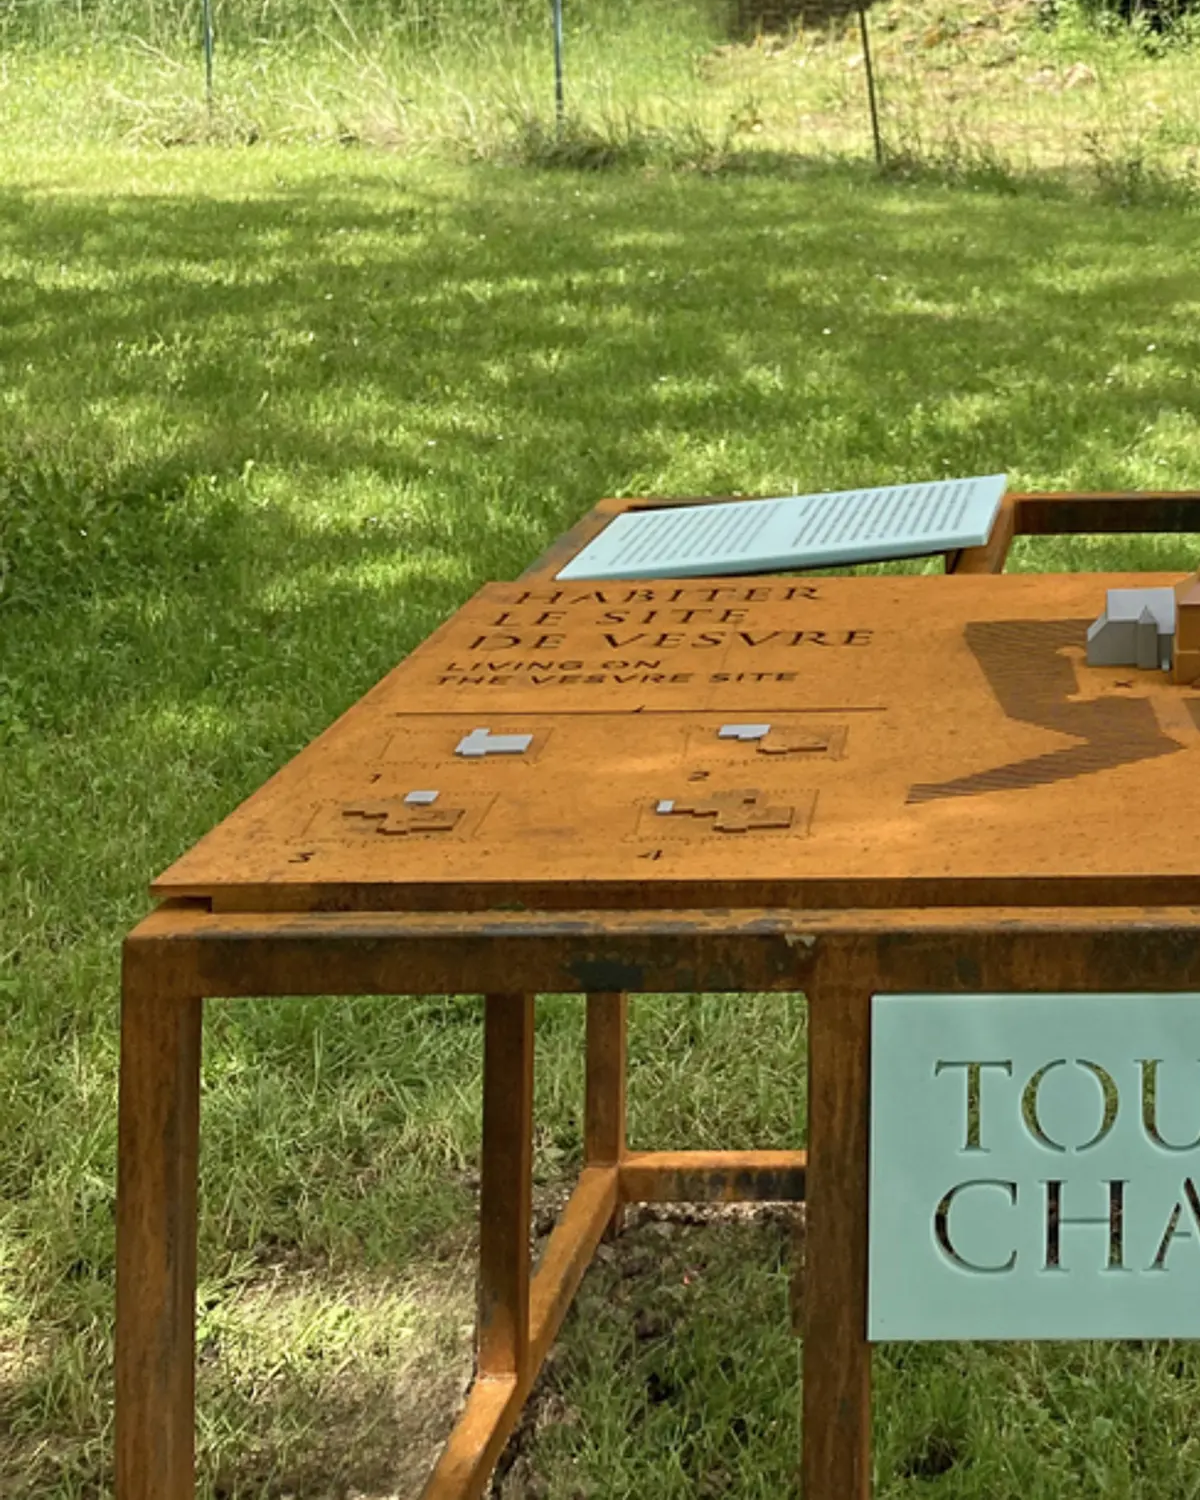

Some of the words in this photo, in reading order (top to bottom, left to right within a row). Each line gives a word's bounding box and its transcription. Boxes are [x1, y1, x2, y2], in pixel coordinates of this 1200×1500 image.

[514, 588, 824, 604] HABITER
[488, 611, 568, 626] LE
[595, 609, 750, 624] SITE
[467, 634, 568, 651] DE
[602, 630, 875, 648] VESVRE
[446, 661, 585, 671] LIVING
[601, 660, 661, 669] ON
[437, 675, 514, 685] THE
[530, 672, 695, 684] VESVRE
[708, 672, 800, 683] SITE
